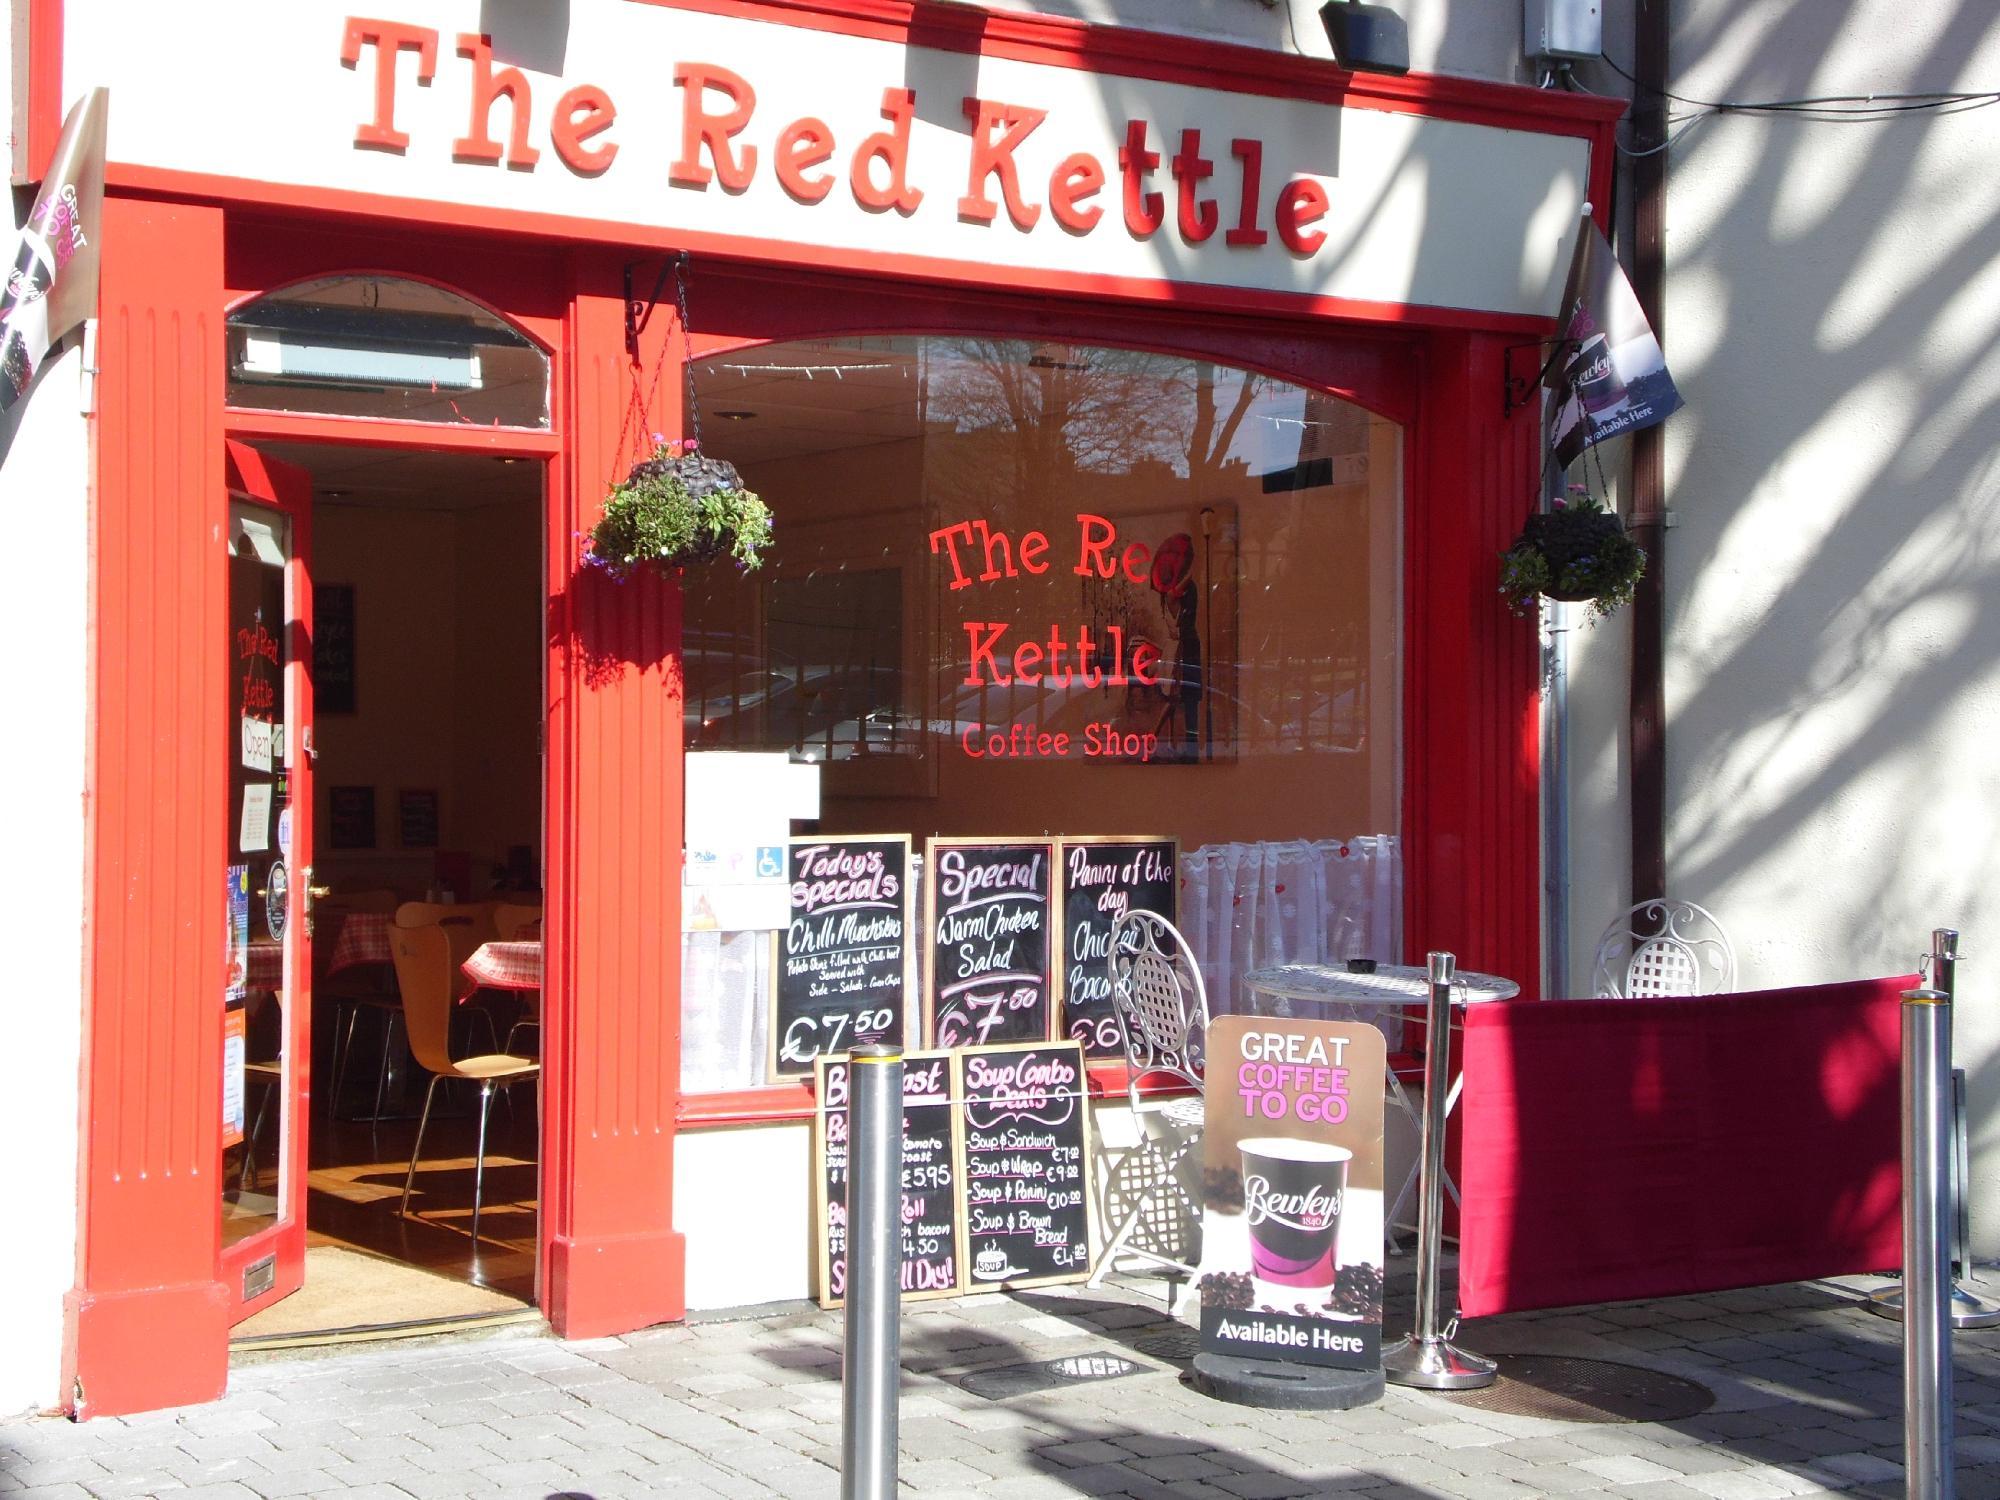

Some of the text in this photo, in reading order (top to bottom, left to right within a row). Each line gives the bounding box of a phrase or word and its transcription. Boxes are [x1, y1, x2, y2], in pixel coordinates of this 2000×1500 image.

[340, 16, 1330, 259] The Red Kettle
[1629, 406, 1654, 423] Here
[929, 519, 1050, 590] The
[962, 622, 1162, 689] Kettle
[245, 725, 271, 764] Open
[961, 722, 1158, 763] Coffee Shop
[795, 845, 884, 879] Today's
[940, 851, 1042, 905] Special
[1069, 847, 1172, 890] Panini of the
[1097, 884, 1129, 923] day
[937, 904, 1040, 946] Warm Chicken
[958, 938, 1015, 979] Salad
[1240, 1031, 1350, 1066] GREAT
[966, 1053, 1075, 1090] Soup Combo
[1238, 1062, 1350, 1095] COFFEE
[989, 1084, 1048, 1111] Deals
[1238, 1089, 1349, 1125] TO GO
[902, 1136, 943, 1151] tomato
[1007, 1128, 1057, 1149] Sandwich
[1015, 1179, 1048, 1201] Panini
[1245, 1174, 1344, 1228] Bewley's
[917, 1222, 951, 1236] bacon
[1018, 1210, 1052, 1230] Brown
[1033, 1225, 1068, 1245] Bread
[1302, 1215, 1323, 1227] 1840
[916, 1256, 955, 1290] Day!
[979, 1261, 1003, 1273] SOUP
[1216, 1317, 1365, 1353] Available Here
